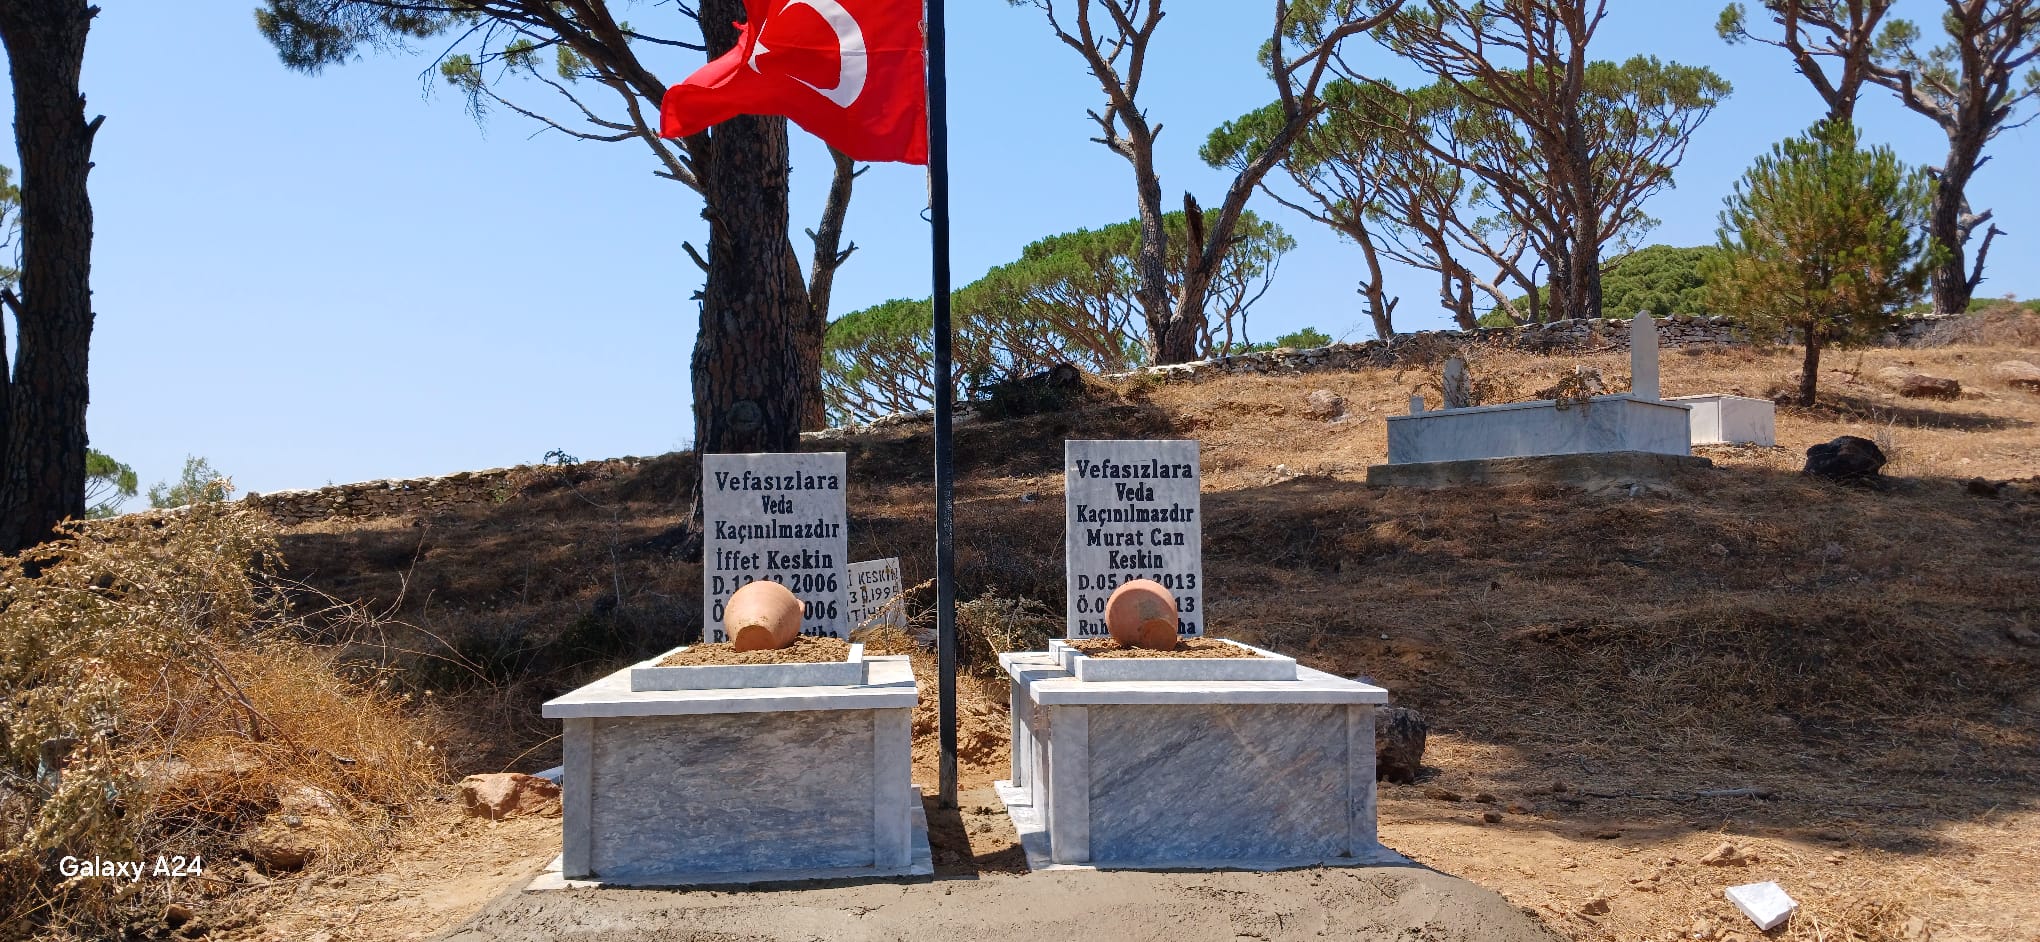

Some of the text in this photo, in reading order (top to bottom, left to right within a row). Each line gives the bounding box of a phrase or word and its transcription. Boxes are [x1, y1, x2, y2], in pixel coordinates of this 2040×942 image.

[1076, 459, 1193, 479] Vefasızlara
[715, 471, 839, 491] Vefasızlara
[1115, 482, 1155, 502] Veda
[761, 494, 794, 514] Veda
[1076, 503, 1195, 527] Kaçınılmazdır
[715, 519, 840, 544] Kaçınılmazdır
[1086, 528, 1185, 546] Murat Can
[716, 548, 833, 571] İffet Keskin
[1109, 549, 1164, 570] Keskin
